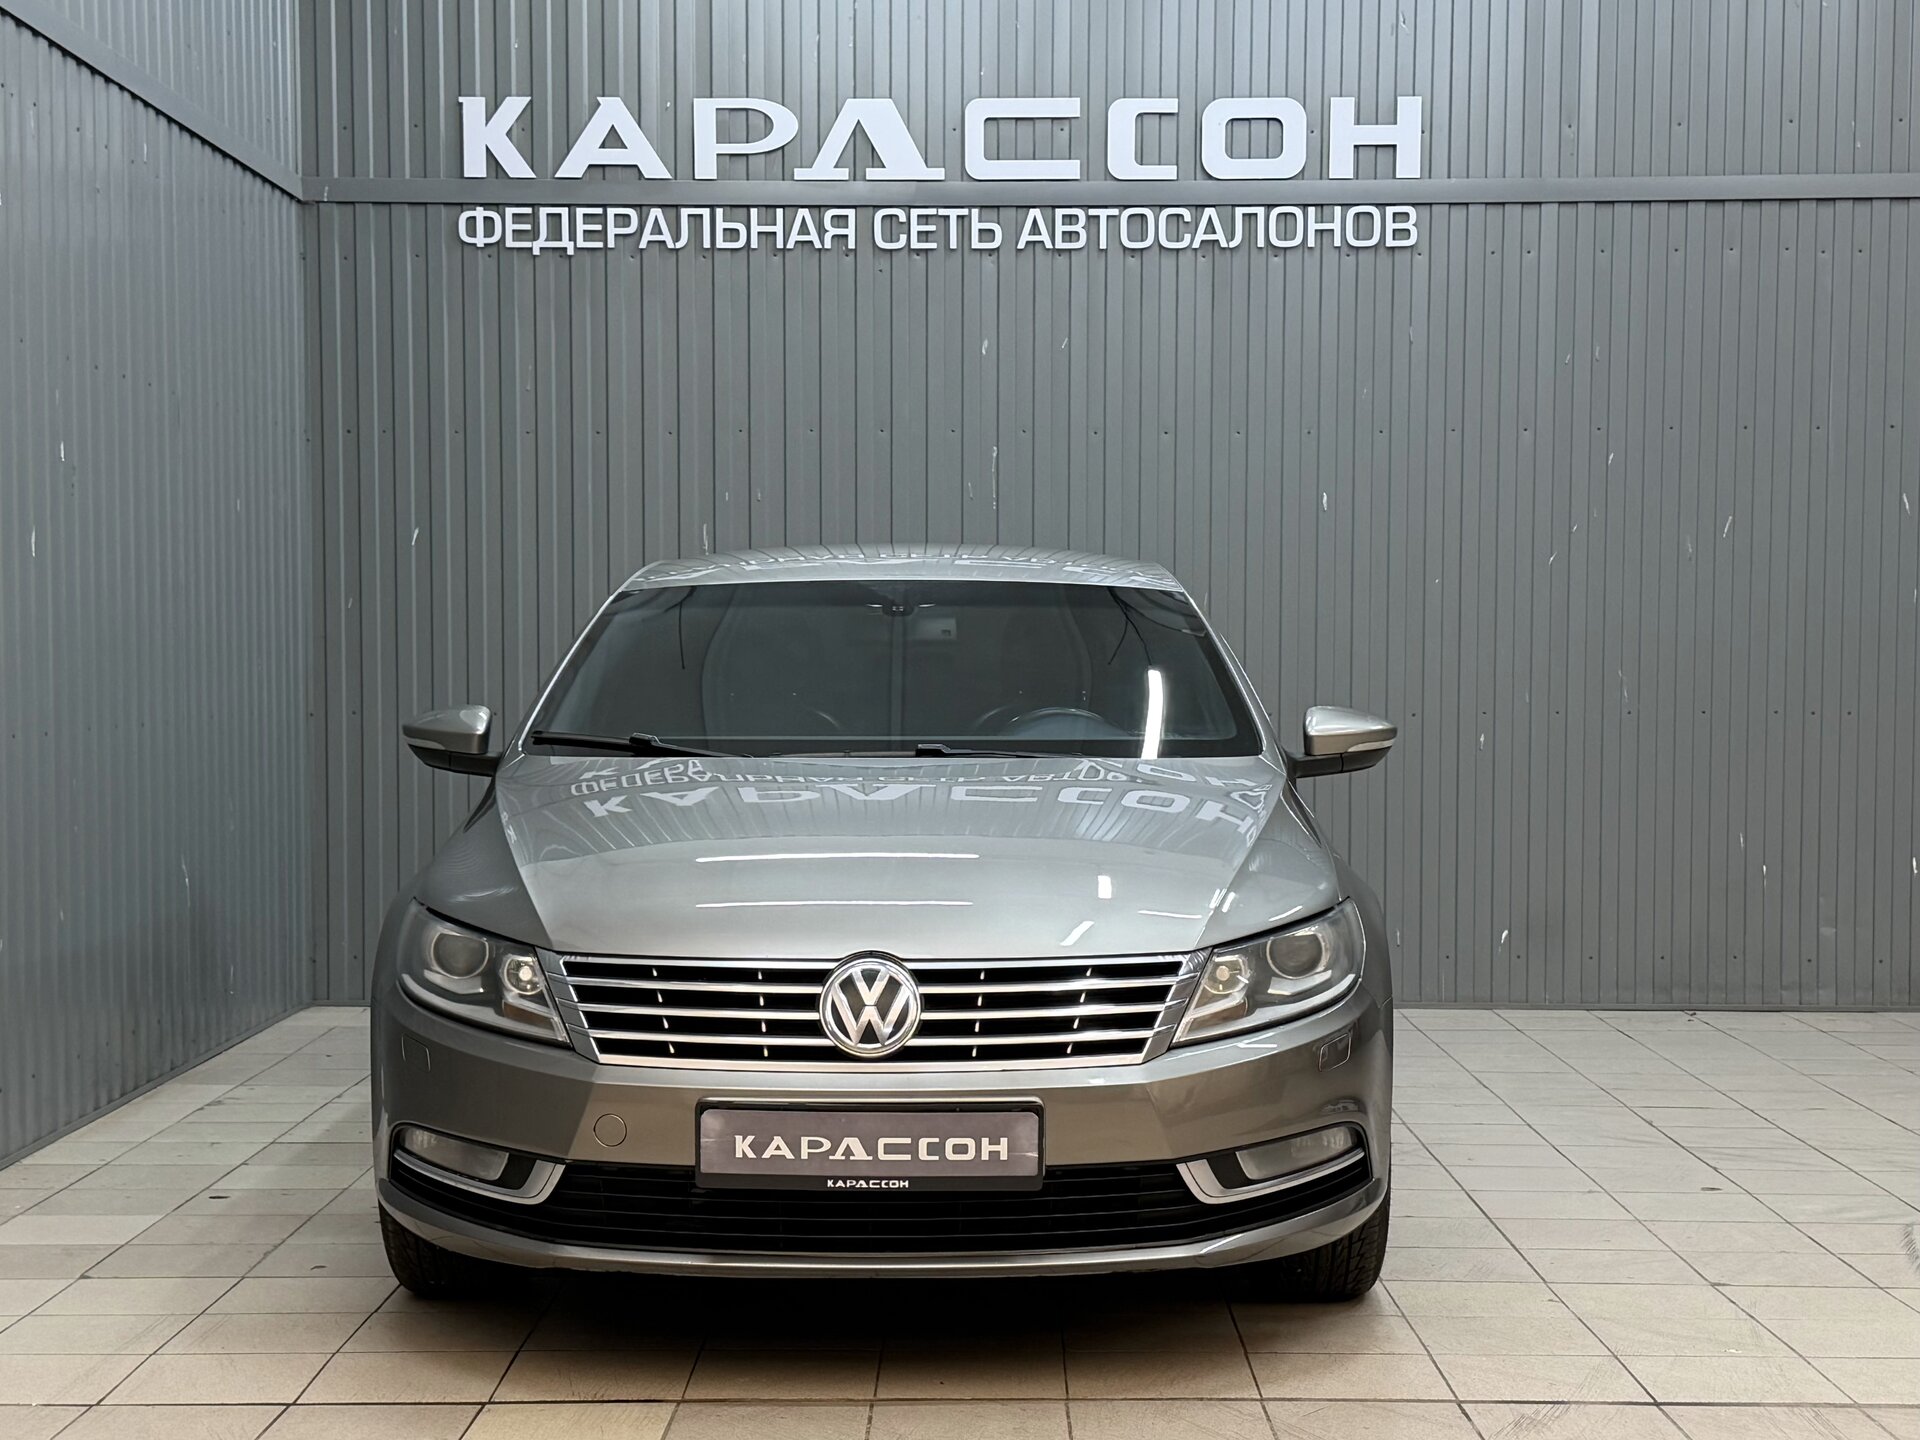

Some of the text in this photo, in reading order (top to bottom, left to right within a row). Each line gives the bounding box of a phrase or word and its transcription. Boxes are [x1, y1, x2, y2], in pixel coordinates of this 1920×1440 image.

[458, 205, 1419, 256] ФЕДЕРАЛЬНАЯ СЕТЬ АВТОСАЛОНОВ
[826, 963, 914, 1050] VW
